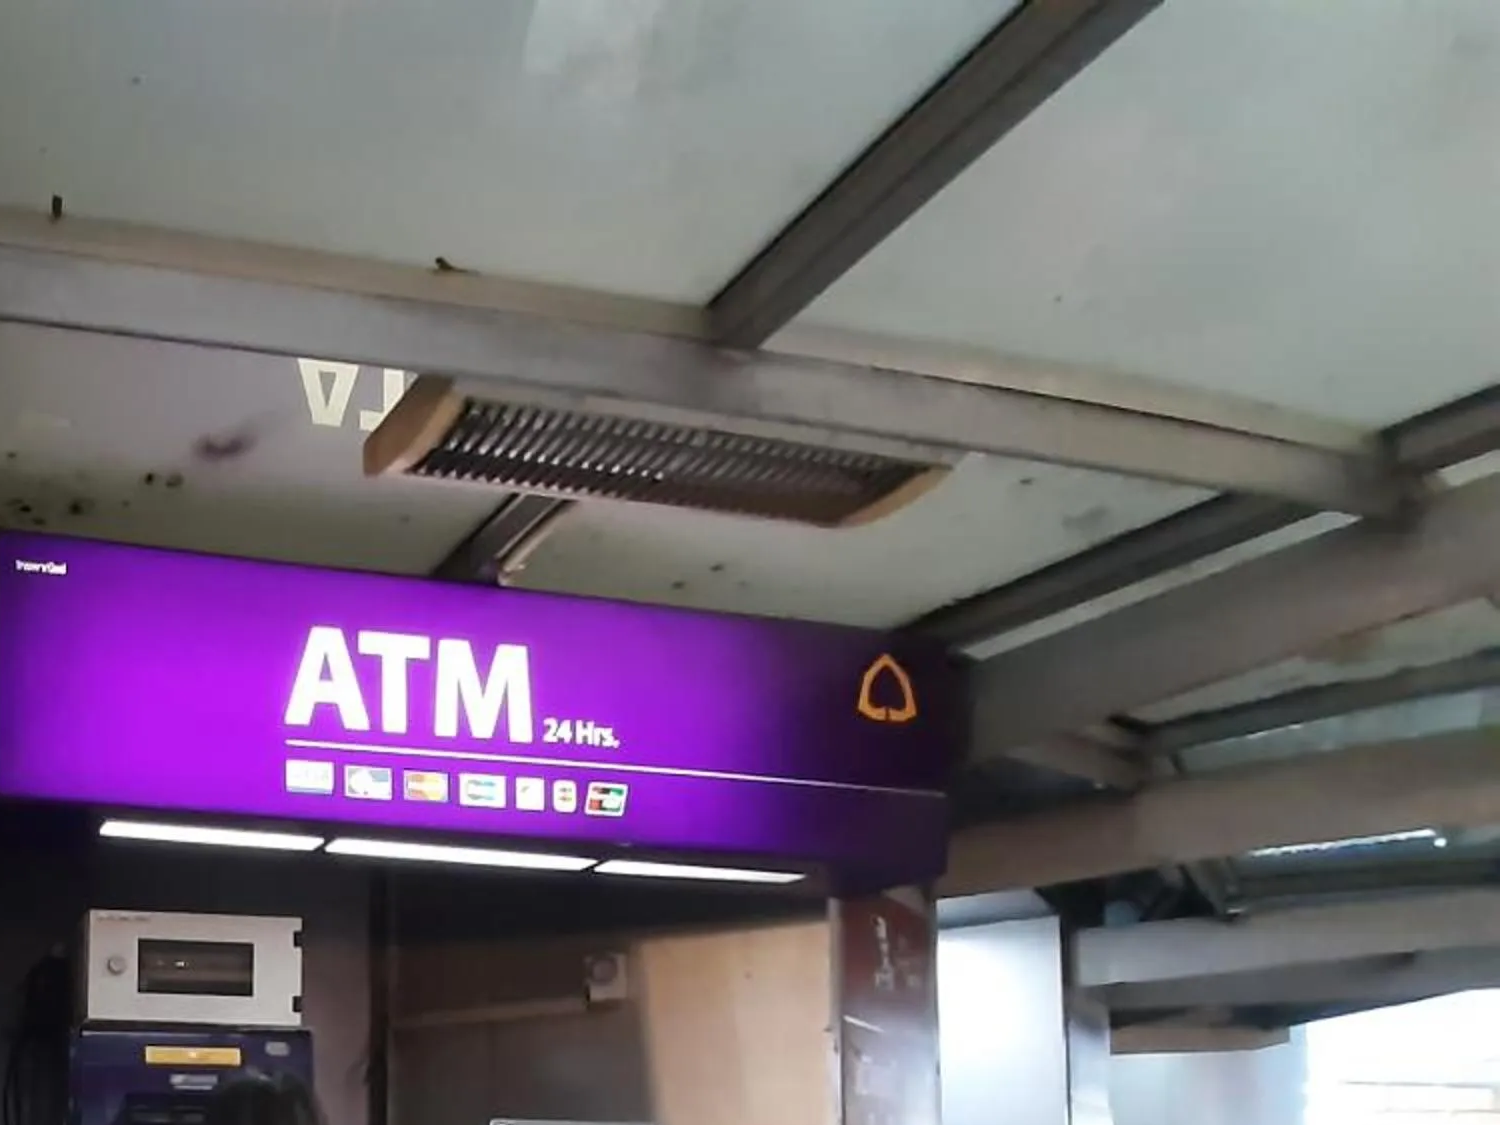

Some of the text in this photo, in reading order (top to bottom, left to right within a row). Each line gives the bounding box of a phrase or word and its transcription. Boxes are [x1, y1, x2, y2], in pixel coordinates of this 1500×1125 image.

[284, 626, 620, 748] ATM 24 Hrs.
